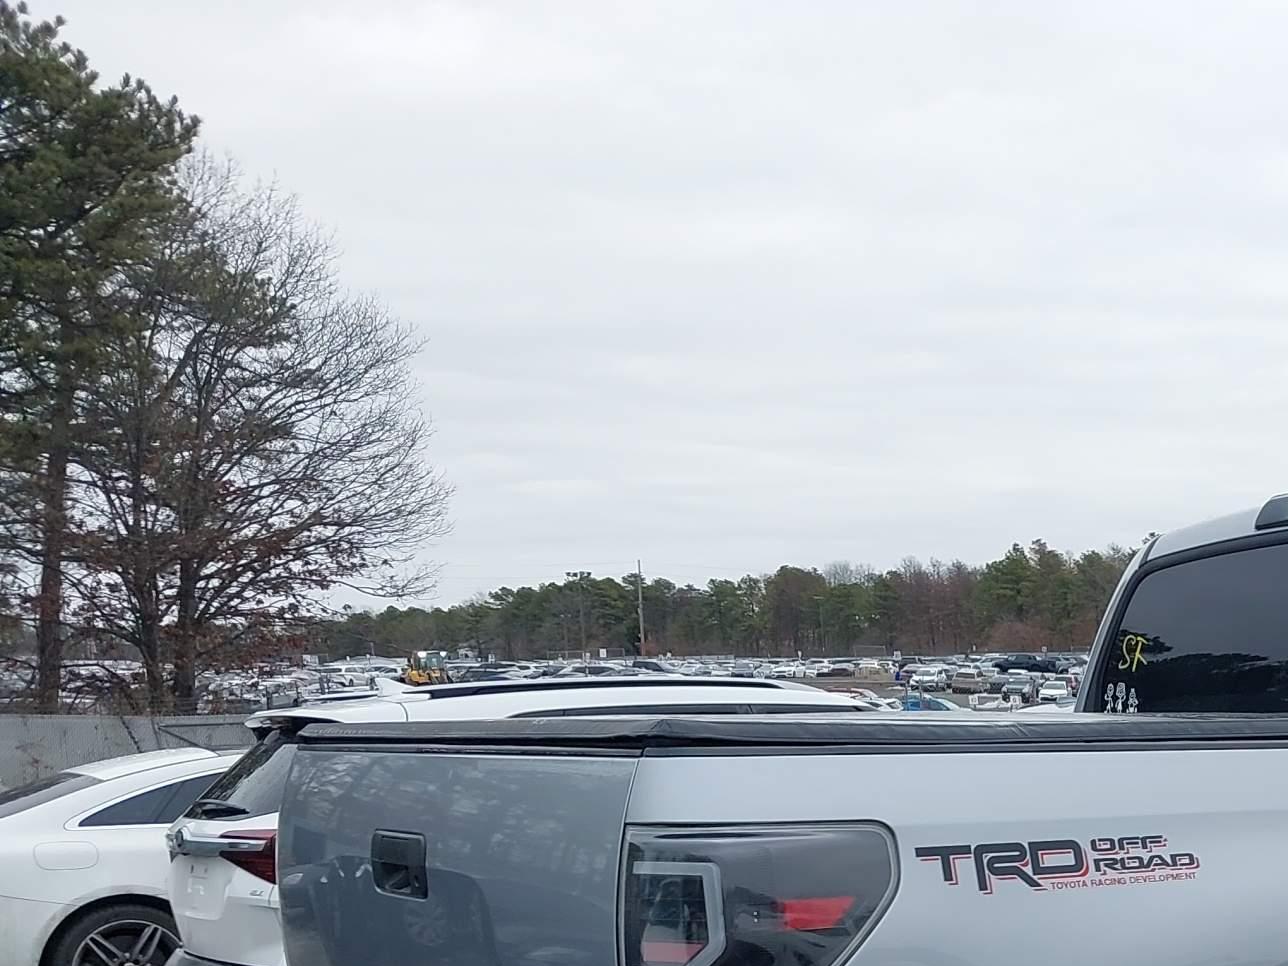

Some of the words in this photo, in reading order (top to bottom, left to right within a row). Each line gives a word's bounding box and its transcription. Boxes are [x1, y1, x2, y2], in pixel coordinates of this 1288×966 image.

[1090, 835, 1167, 855] OFF
[914, 839, 1089, 895] TRD
[1093, 852, 1200, 876] ROAD
[1050, 879, 1088, 890] TOYOTA
[1091, 876, 1127, 887] RACING
[1129, 871, 1197, 884] DEVELOPMENT
